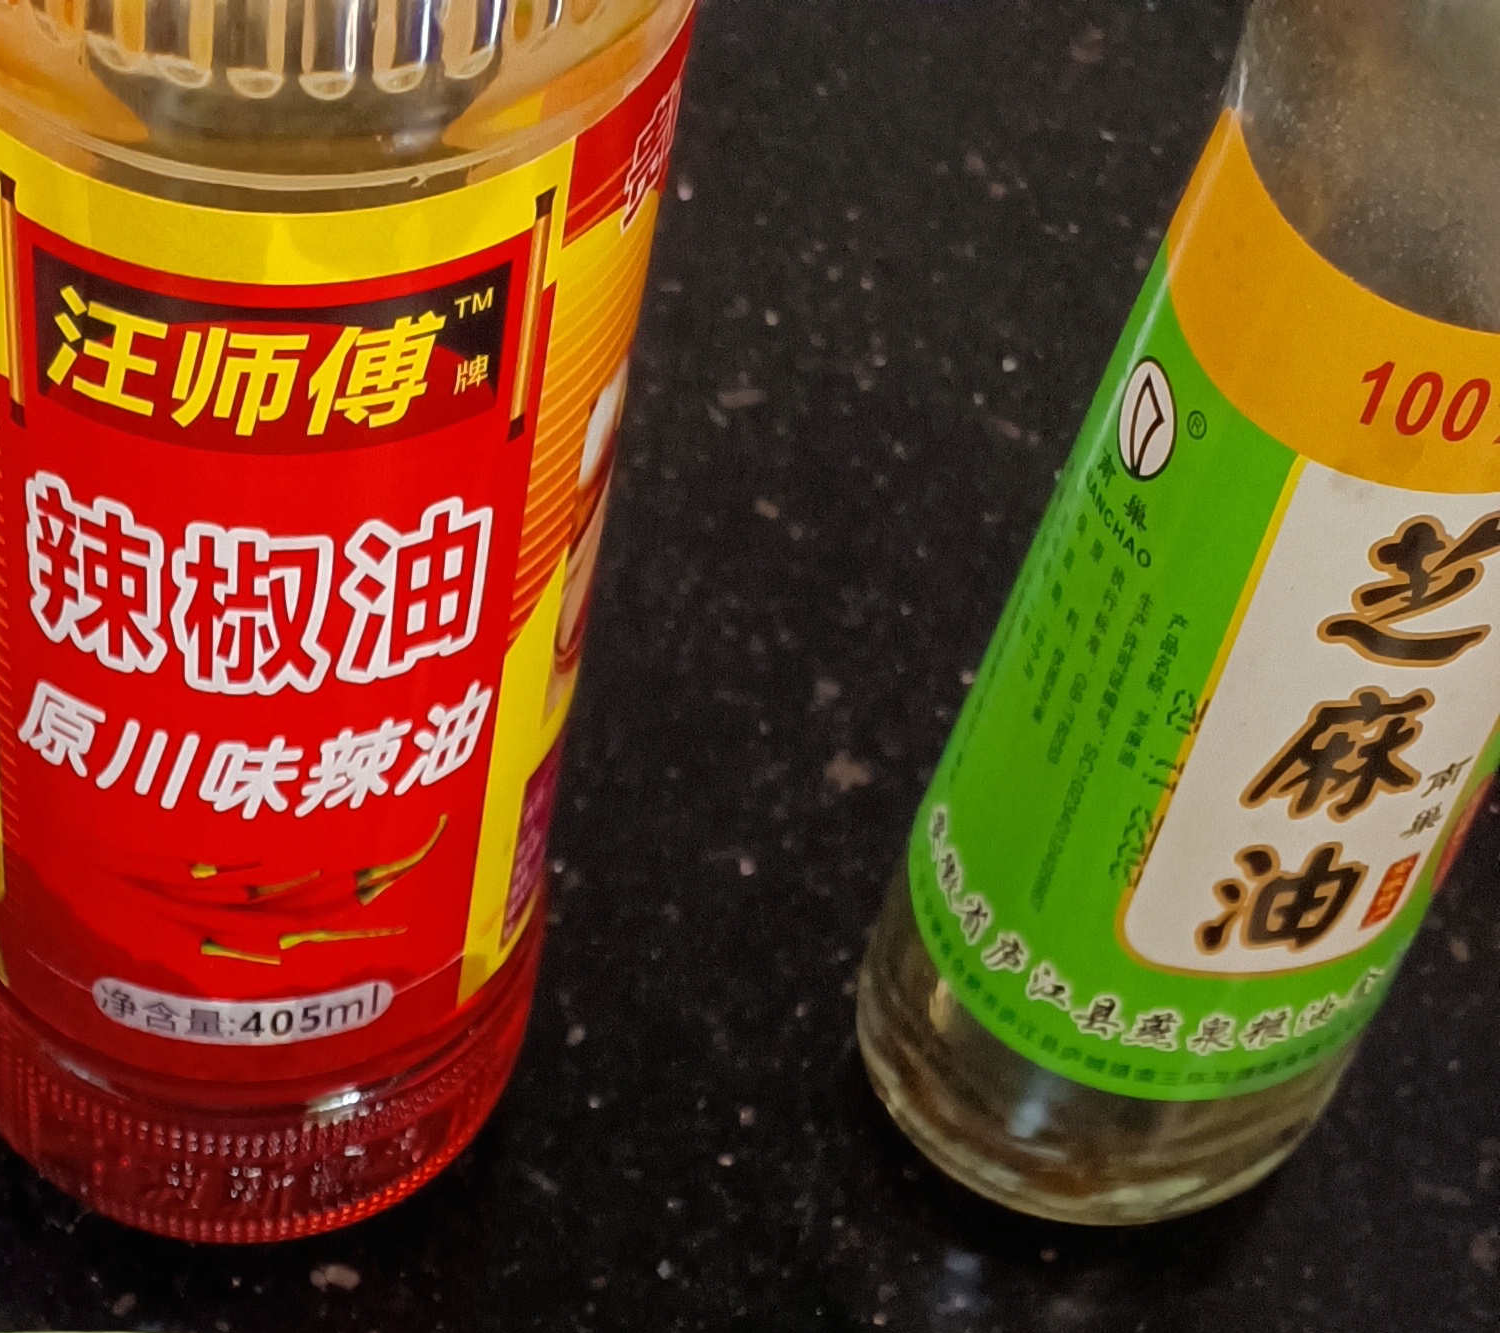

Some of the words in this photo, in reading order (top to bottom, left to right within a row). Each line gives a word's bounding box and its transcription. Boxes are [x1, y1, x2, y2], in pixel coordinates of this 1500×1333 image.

[46, 286, 444, 437] 汪师傅
[453, 354, 490, 395] 牌
[1359, 361, 1500, 445] 100
[25, 470, 493, 693] 辣椒油
[18, 680, 493, 820] 原川味辣油
